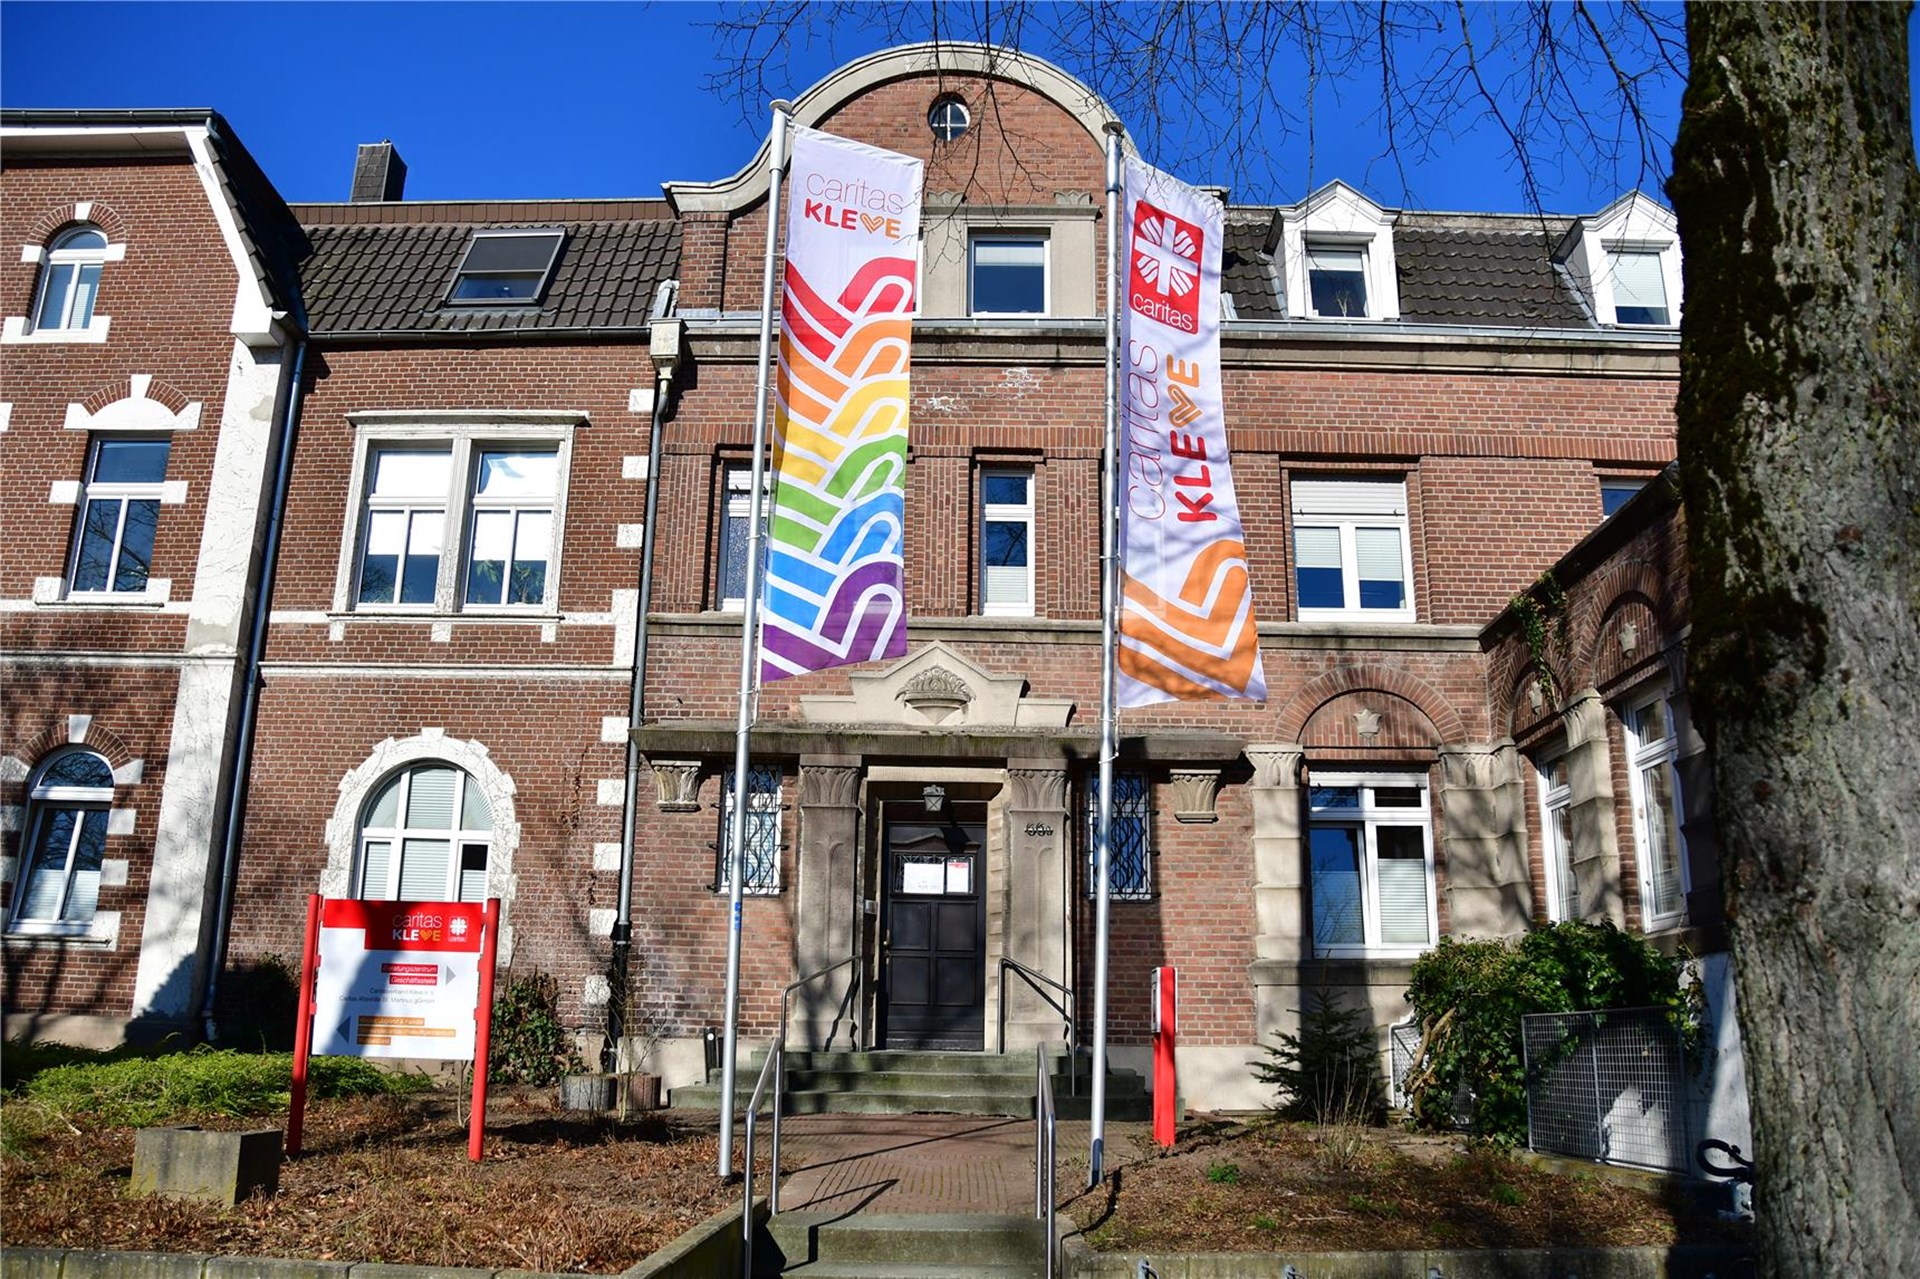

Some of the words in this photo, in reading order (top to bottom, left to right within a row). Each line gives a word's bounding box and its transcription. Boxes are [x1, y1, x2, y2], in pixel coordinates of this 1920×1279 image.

[807, 173, 904, 215] caritas
[1132, 293, 1193, 331] caritas
[1128, 340, 1167, 522] caritas
[393, 912, 442, 929] caritas
